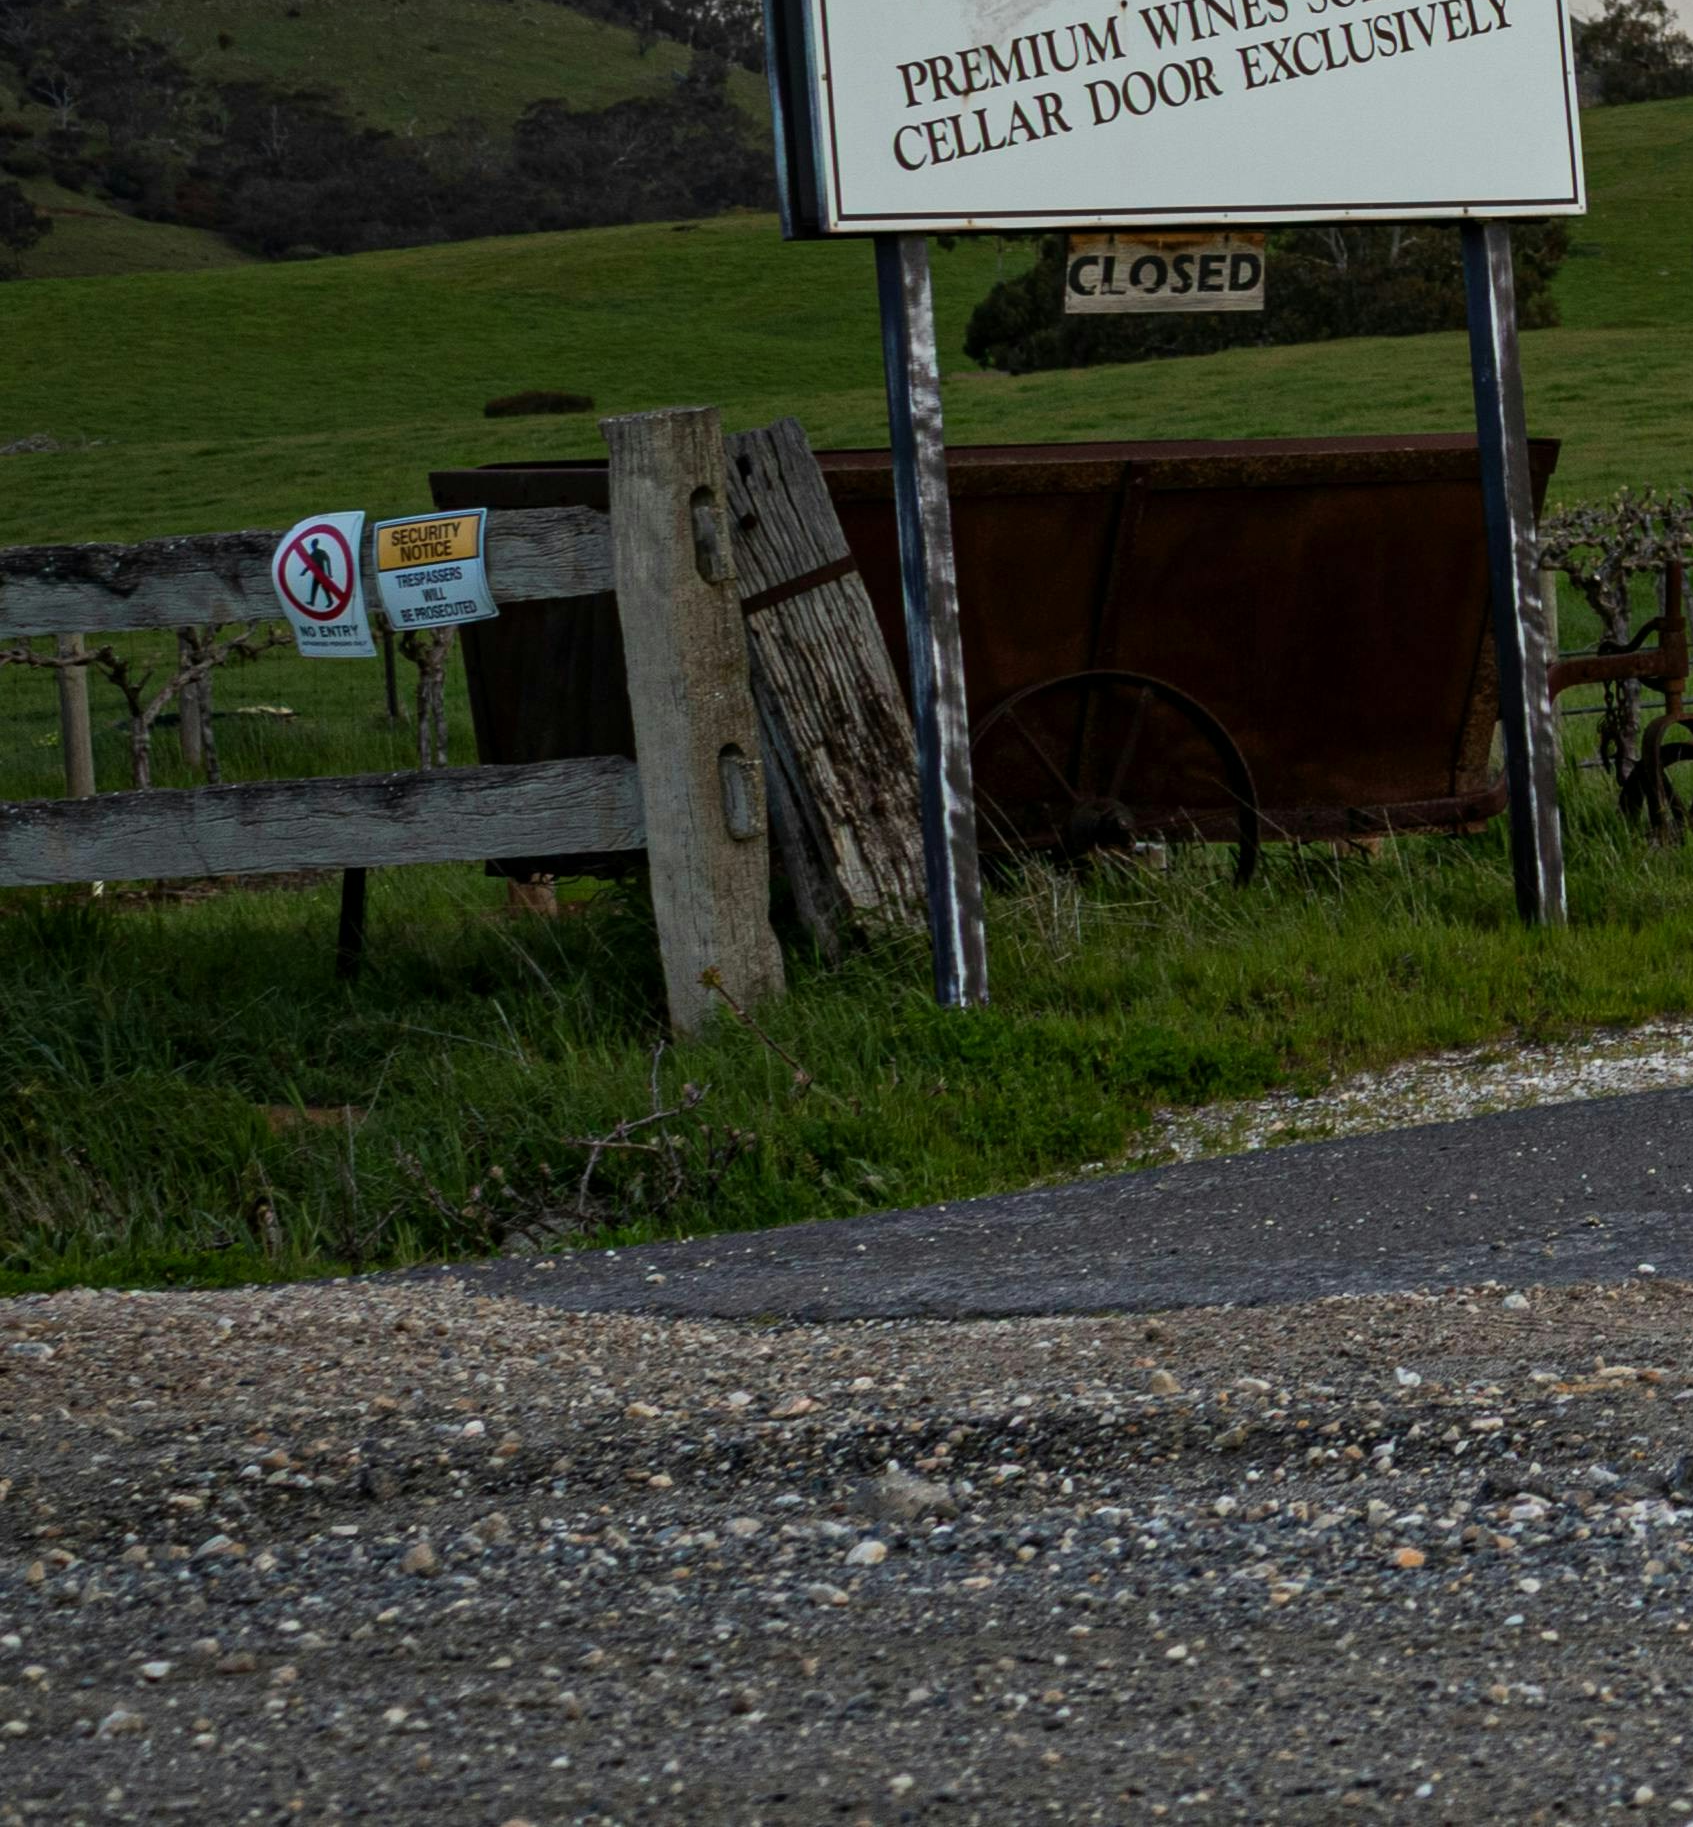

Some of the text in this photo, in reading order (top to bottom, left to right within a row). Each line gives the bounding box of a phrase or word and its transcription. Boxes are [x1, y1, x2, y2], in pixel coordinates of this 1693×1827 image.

[897, 15, 1127, 109] PREMIUM
[893, 90, 1073, 171] CELLAR
[1084, 56, 1224, 126] DOOR
[1068, 253, 1262, 296] CLOSED
[391, 522, 461, 546] SECURITY
[400, 540, 453, 562] NOTICE
[396, 566, 462, 588] TRESPASSERS
[422, 587, 447, 602] WILL
[401, 600, 478, 622] BE PROSECUTED
[300, 625, 358, 638] NO ENTRY
